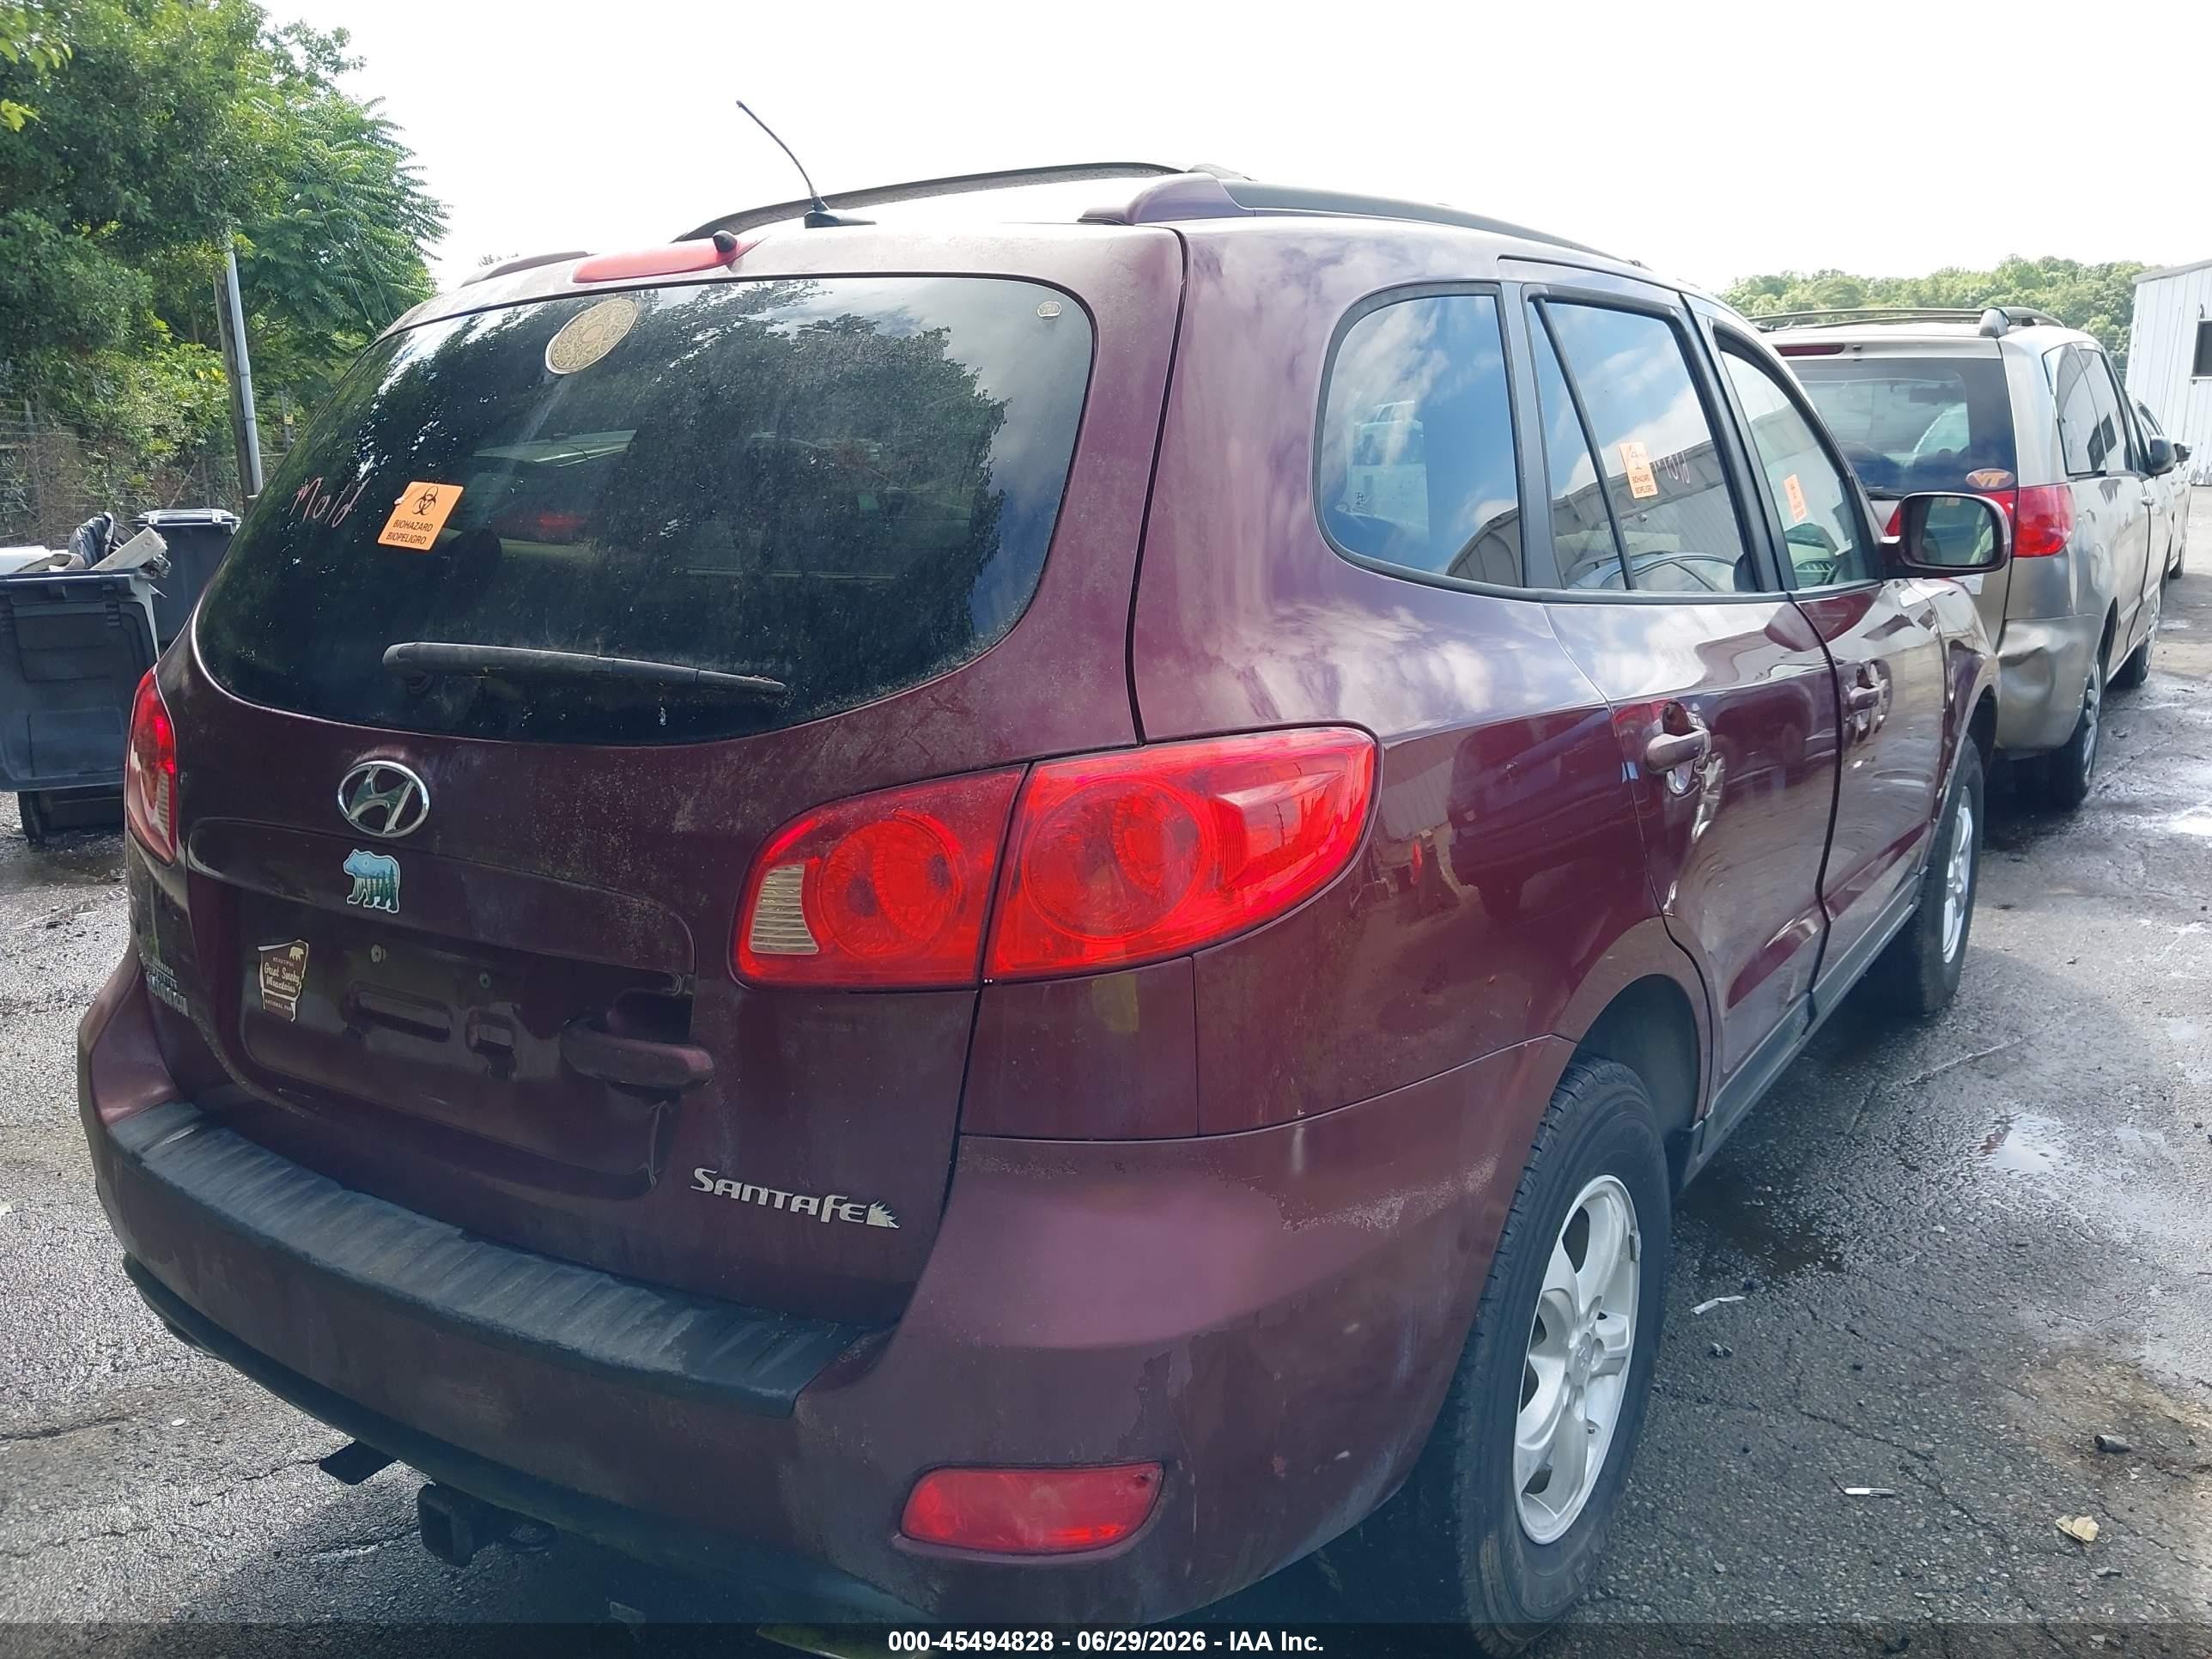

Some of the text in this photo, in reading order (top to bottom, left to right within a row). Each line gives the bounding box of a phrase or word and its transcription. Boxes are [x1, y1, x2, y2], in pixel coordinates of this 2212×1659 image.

[1972, 472, 2008, 488] VT
[289, 477, 372, 528] Mold
[392, 519, 434, 532] BIOHAZARD
[386, 531, 427, 545] BIOPELIGRO
